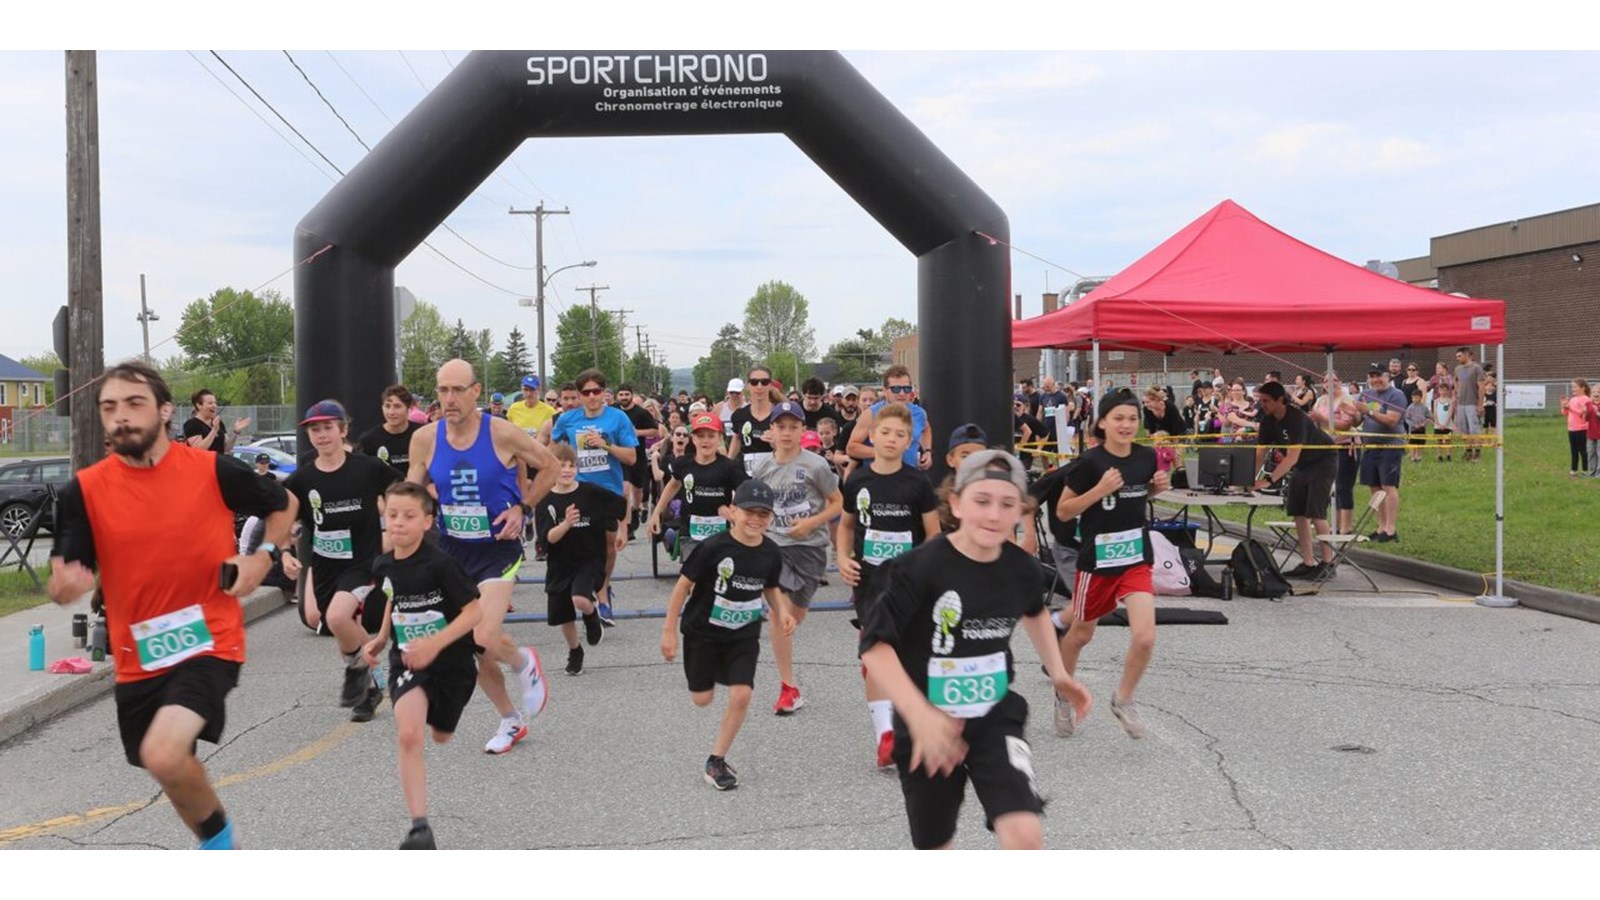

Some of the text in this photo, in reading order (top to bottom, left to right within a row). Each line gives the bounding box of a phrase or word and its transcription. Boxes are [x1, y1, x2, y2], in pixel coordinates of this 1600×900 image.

[526, 54, 768, 85] SPORTCHRONO
[603, 84, 782, 99] Organisation d'événements
[595, 98, 783, 112] Chronometrage électronique
[581, 455, 607, 467] 1040
[450, 469, 481, 506] RU
[450, 516, 481, 531] 679
[696, 524, 721, 536] 525
[871, 542, 905, 559] 528
[1105, 541, 1137, 560] 524
[720, 609, 754, 624] 603
[403, 623, 440, 641] 656
[146, 626, 199, 659] 606
[943, 676, 996, 704] 638
